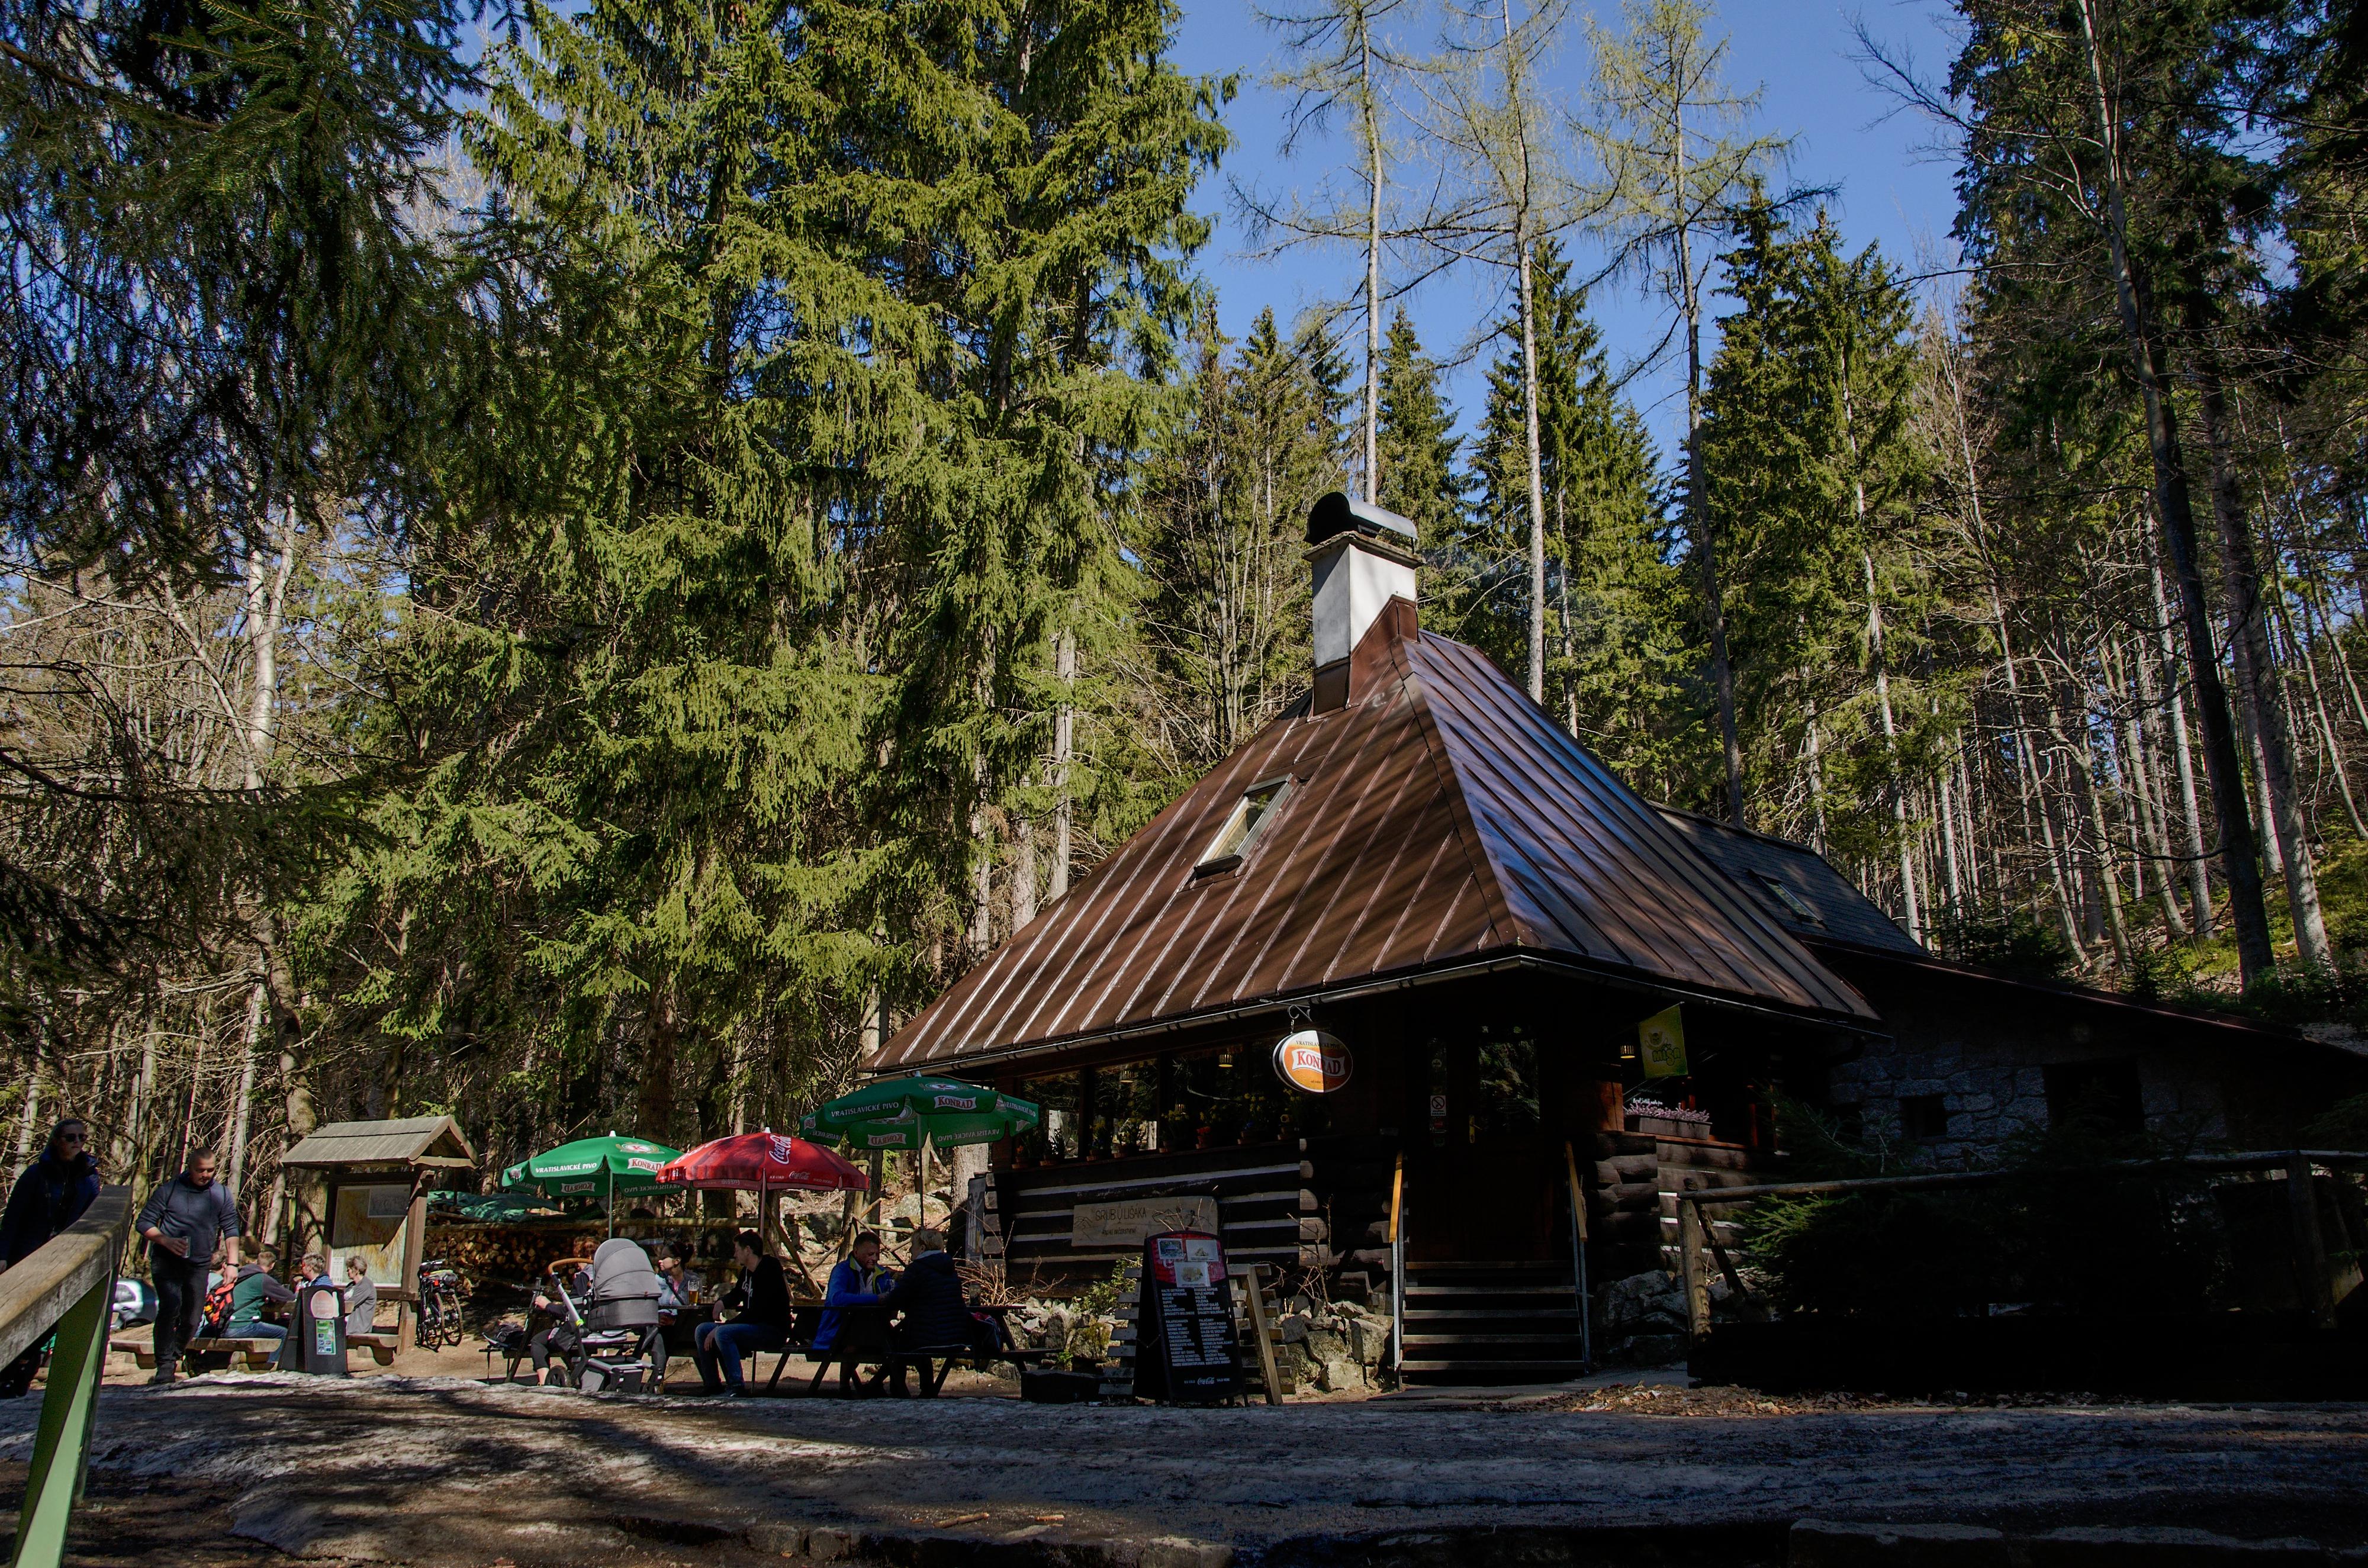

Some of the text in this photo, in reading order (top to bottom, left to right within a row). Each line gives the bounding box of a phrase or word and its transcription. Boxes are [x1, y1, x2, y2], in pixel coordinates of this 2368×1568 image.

[1296, 1051, 1341, 1074] KONRAD
[938, 1096, 973, 1109] KONRAD
[831, 1102, 880, 1118] VRATISLAVICKÉ
[535, 1163, 581, 1173] VRATISLAVICKÉ
[632, 1158, 662, 1171] KONRAD
[1095, 1208, 1117, 1221] SRUB
[1124, 1203, 1147, 1219] LIŠÁKA
